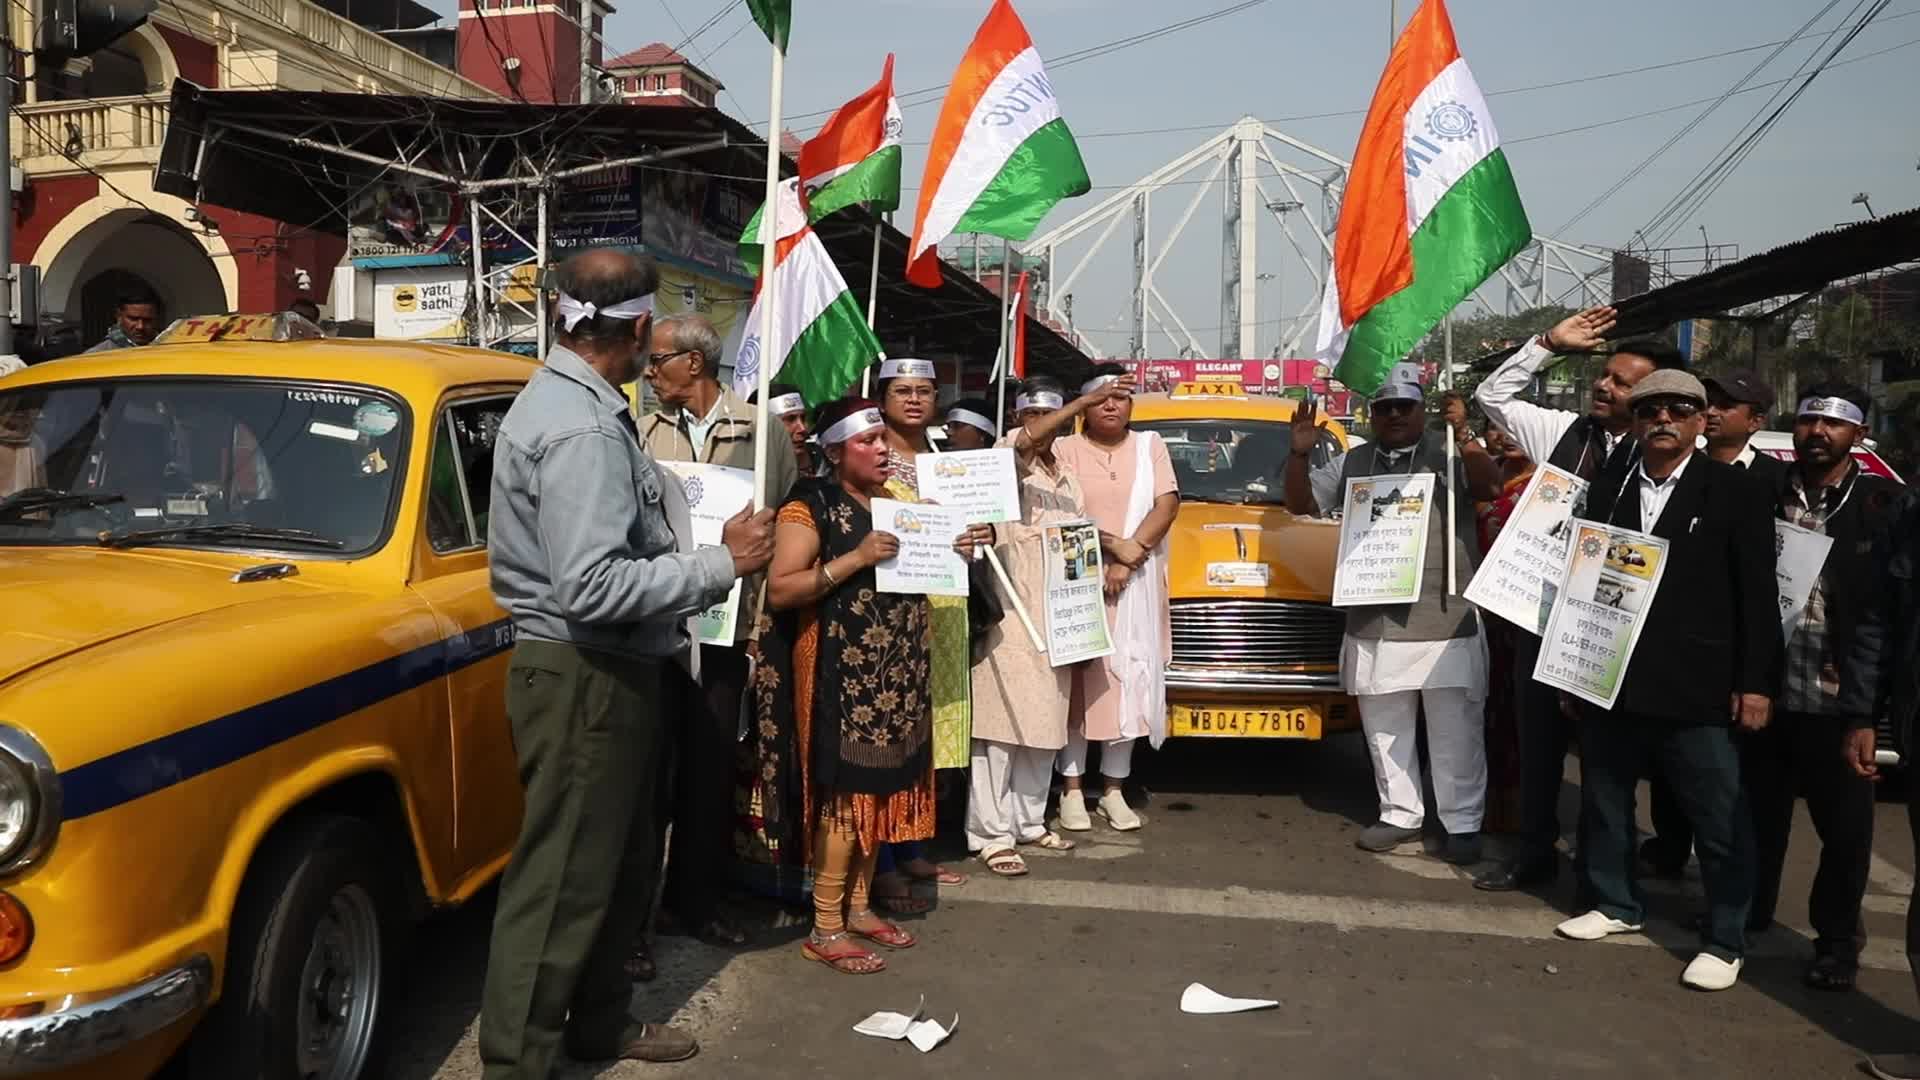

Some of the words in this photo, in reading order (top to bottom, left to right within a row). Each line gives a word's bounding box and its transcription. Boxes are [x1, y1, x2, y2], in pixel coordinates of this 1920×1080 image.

[360, 246, 385, 256] 1800
[421, 283, 451, 298] yatri
[421, 298, 453, 310] sathi
[186, 318, 267, 338] TAXI
[1195, 362, 1243, 372] ELEGANT
[1184, 384, 1234, 395] TAXI
[1259, 711, 1306, 731] 7816
